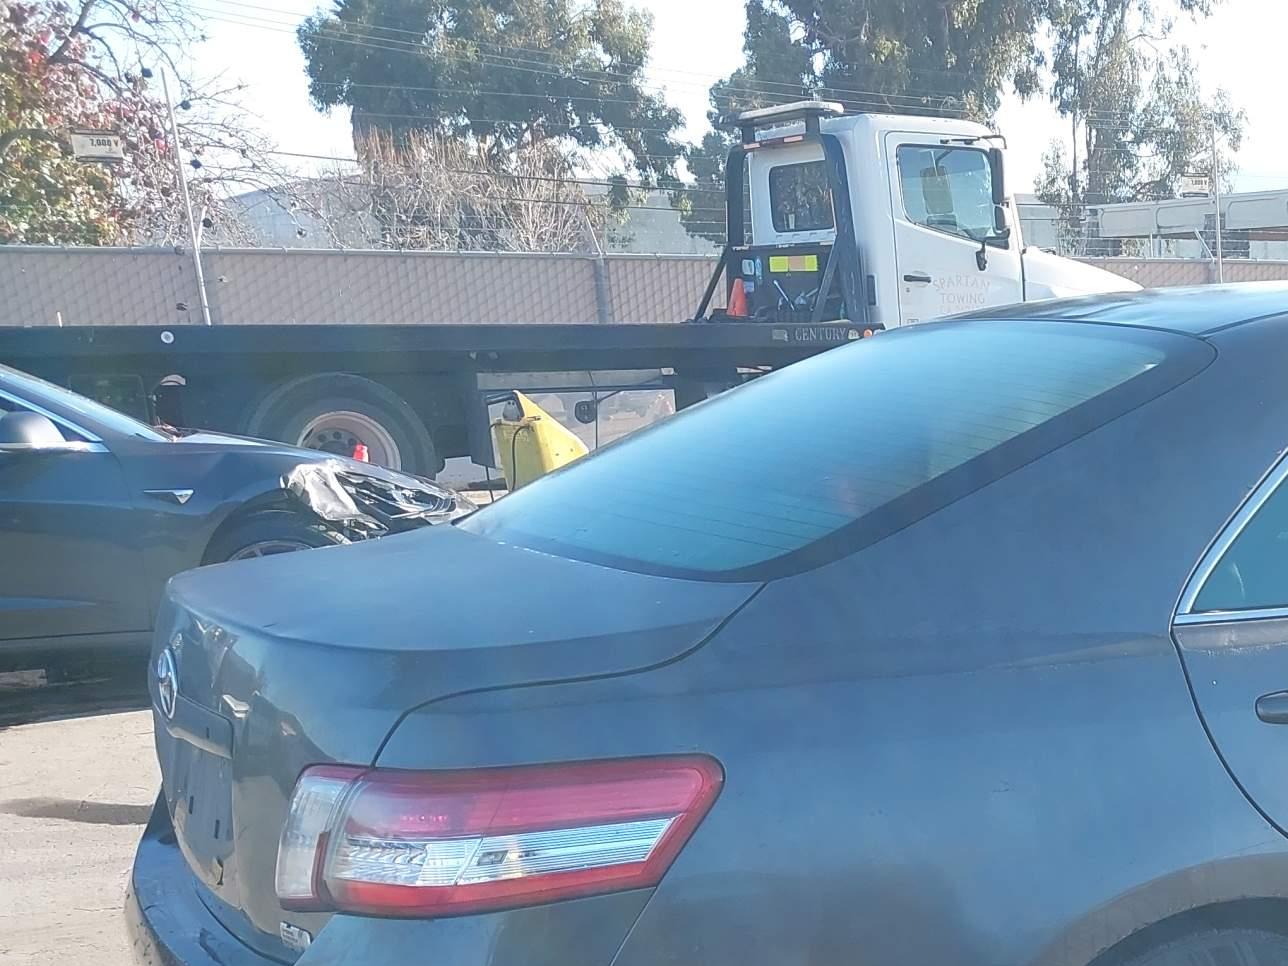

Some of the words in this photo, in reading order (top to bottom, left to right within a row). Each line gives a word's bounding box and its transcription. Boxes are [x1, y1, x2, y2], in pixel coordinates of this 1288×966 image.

[89, 138, 112, 147] 7,000
[113, 139, 119, 147] V
[940, 292, 985, 304] TOWING
[795, 327, 846, 341] CENTURY
